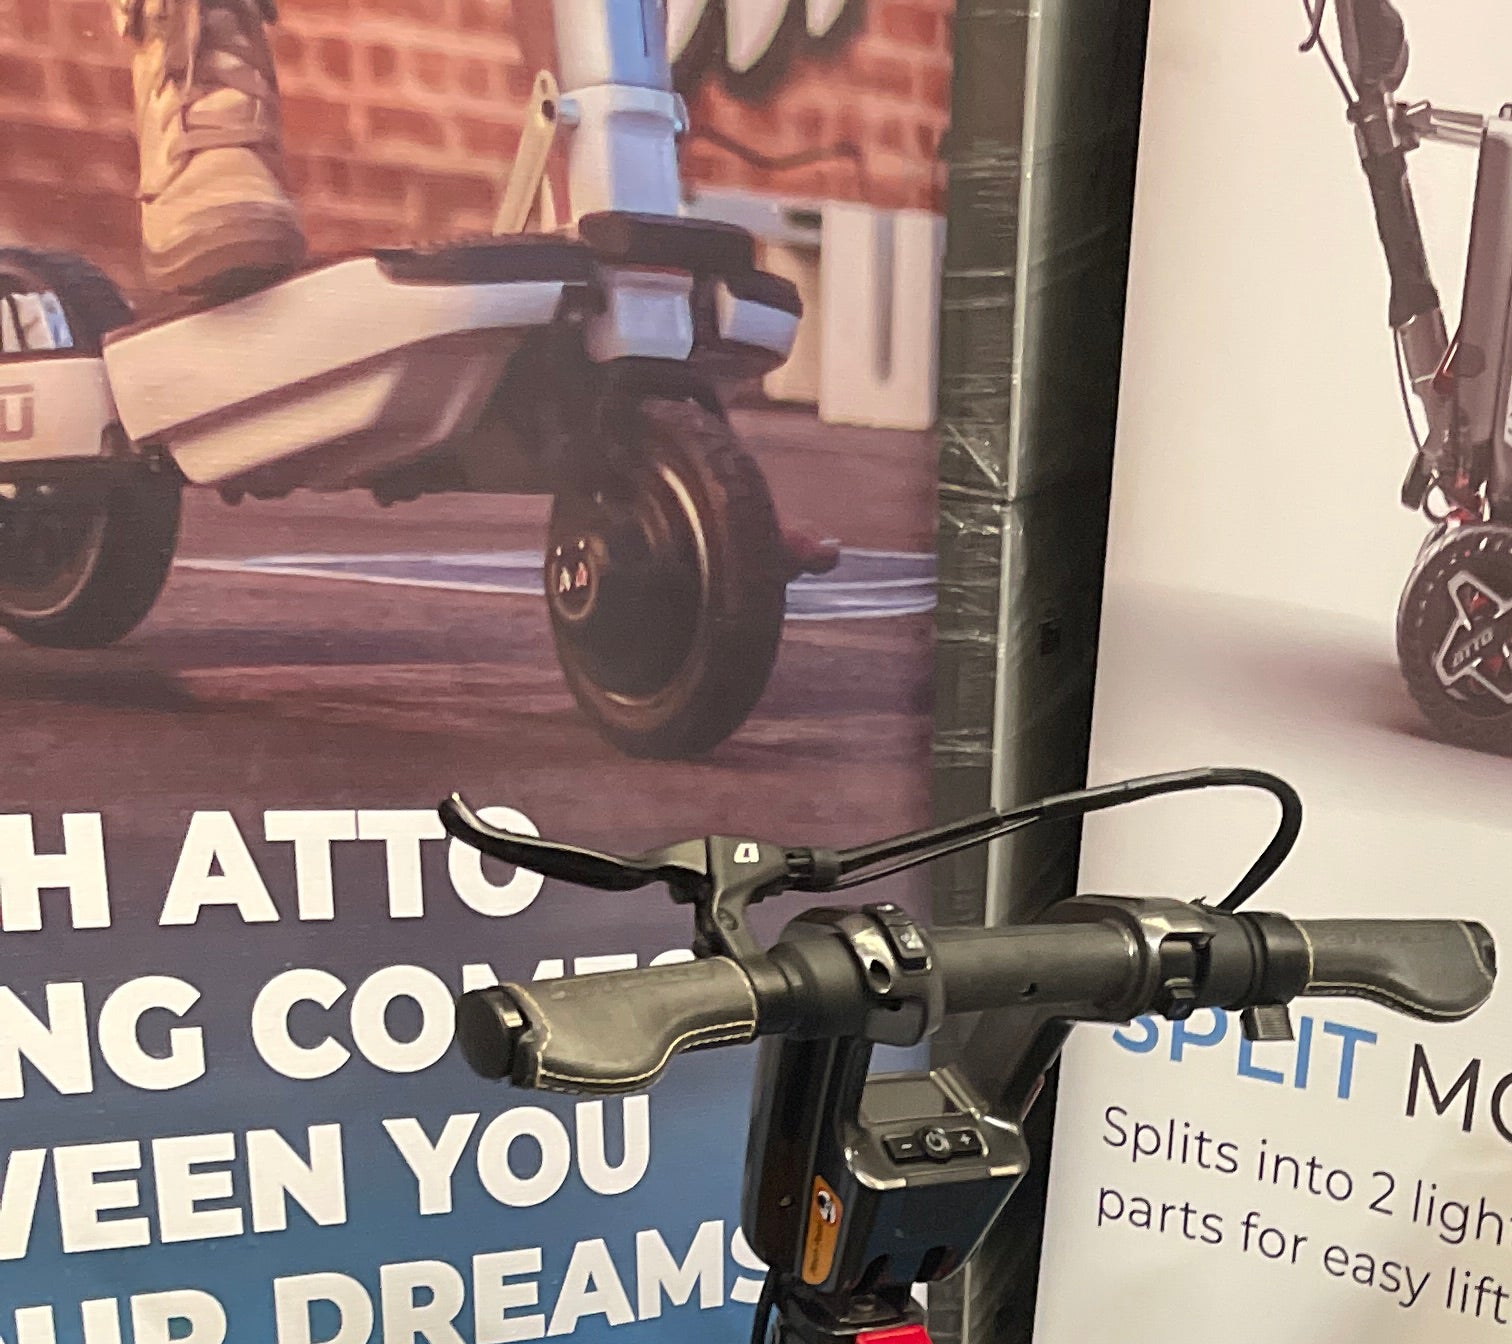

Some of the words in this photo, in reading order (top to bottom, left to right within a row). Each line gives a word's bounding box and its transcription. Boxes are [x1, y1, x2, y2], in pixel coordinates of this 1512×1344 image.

[159, 806, 546, 926] ATTO
[381, 1093, 651, 1216] YOU
[1102, 1105, 1240, 1175] Splits
[1257, 1137, 1355, 1202] into
[1367, 1171, 1396, 1216] 2
[1097, 1184, 1224, 1247] parts
[1241, 1211, 1310, 1266] for
[1323, 1243, 1432, 1310] easy
